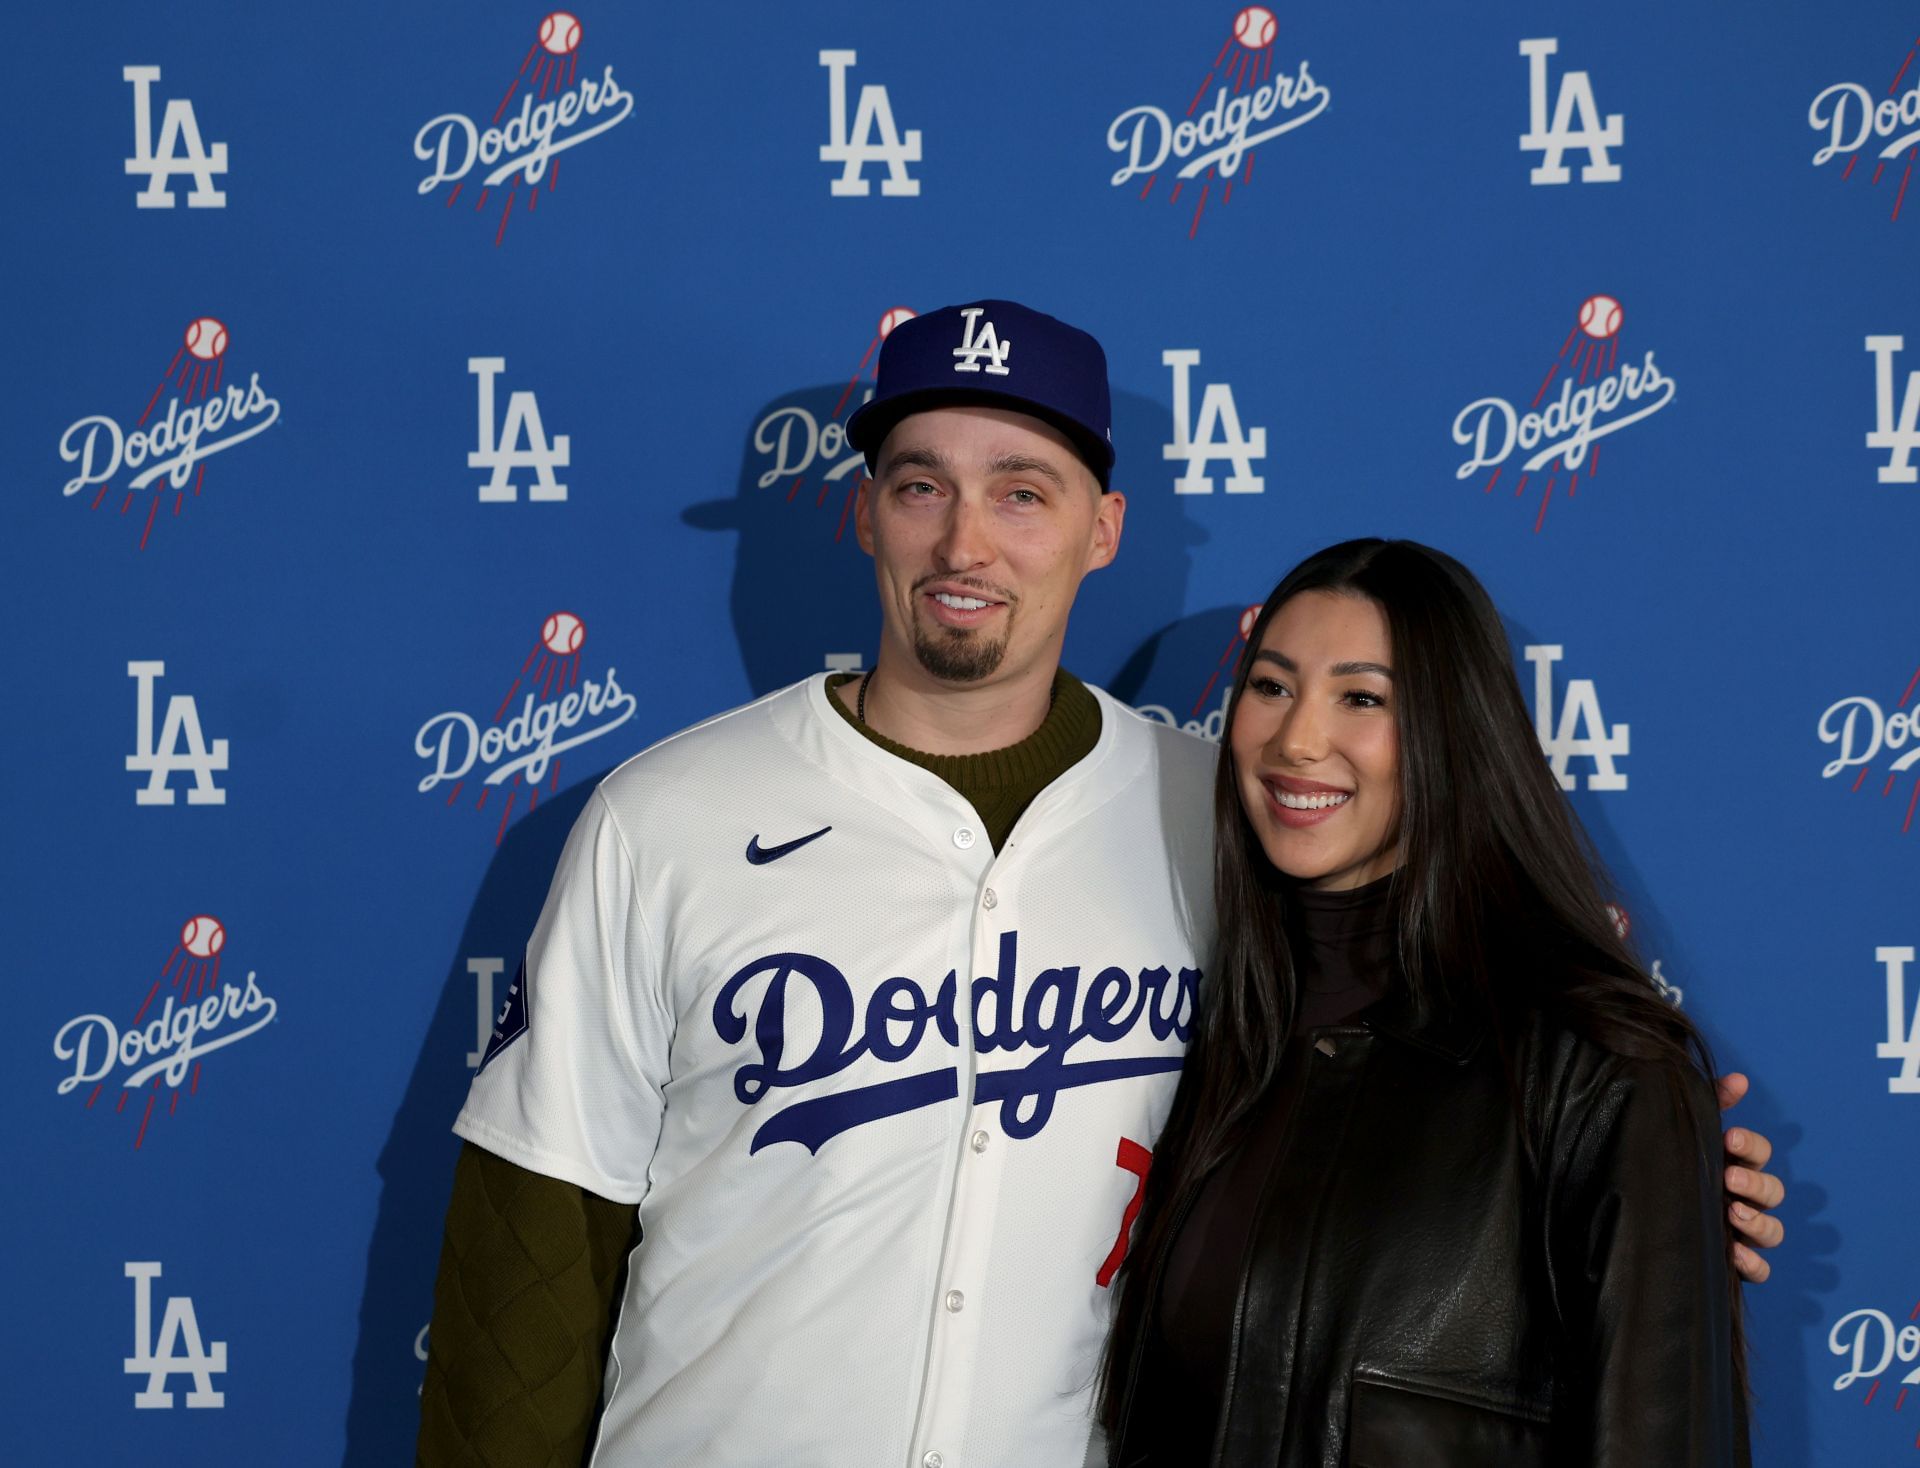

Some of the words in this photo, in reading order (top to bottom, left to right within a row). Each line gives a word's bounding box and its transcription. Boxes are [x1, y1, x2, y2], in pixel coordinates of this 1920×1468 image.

[123, 65, 228, 209] LA
[414, 65, 635, 194] Dodgers
[819, 49, 922, 197] LA
[1107, 61, 1330, 186] Dodgers
[1519, 38, 1624, 185] LA
[952, 307, 1011, 376] LA
[59, 372, 281, 497] Dodgers
[467, 357, 570, 502] LA
[1162, 349, 1267, 495] LA
[1452, 351, 1675, 480] Dodgers
[125, 660, 229, 805] LA
[415, 667, 637, 793] Dodgers
[1525, 644, 1630, 791] LA
[53, 971, 278, 1095] Dodgers
[713, 931, 1204, 1157] Dodgers
[124, 1261, 228, 1409] LA
